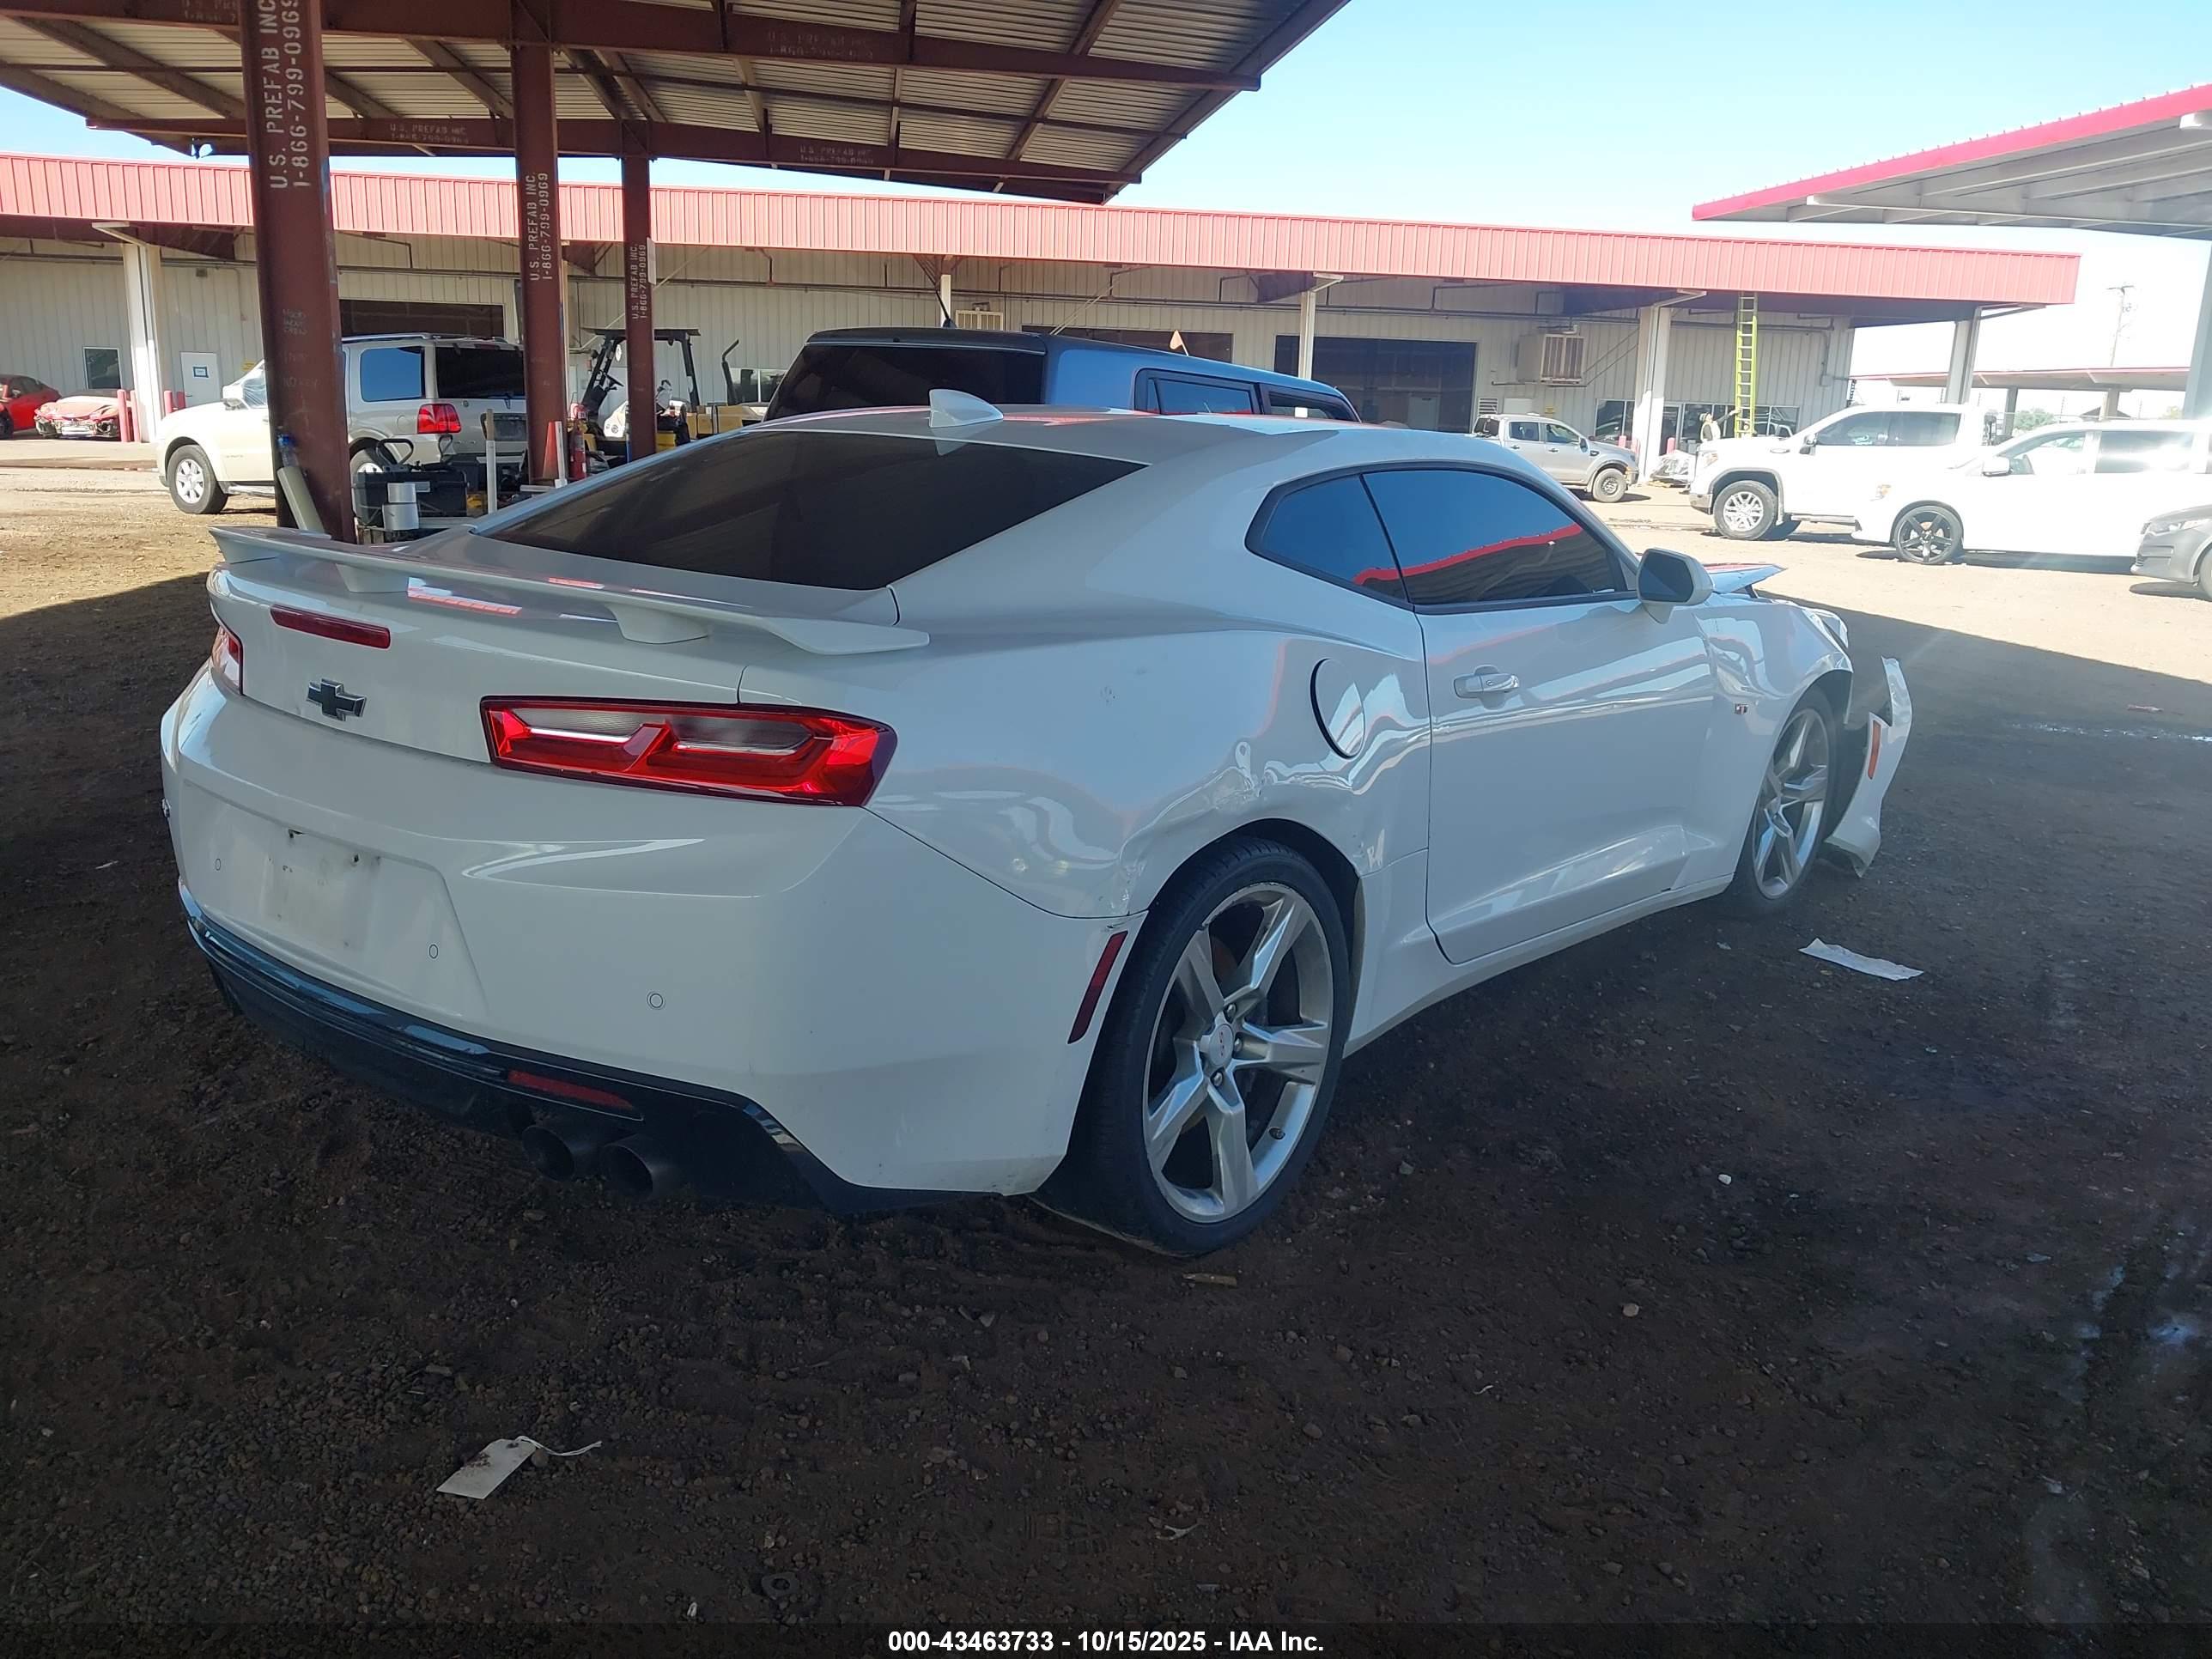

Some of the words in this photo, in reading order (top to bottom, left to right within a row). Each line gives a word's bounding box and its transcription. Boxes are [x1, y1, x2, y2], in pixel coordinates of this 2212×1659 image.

[260, 47, 285, 134] PREFAB
[268, 148, 289, 189] U.S.
[526, 202, 539, 250] PREFAB
[538, 173, 553, 280] 1-866-799-0969
[529, 257, 540, 281] U.S.
